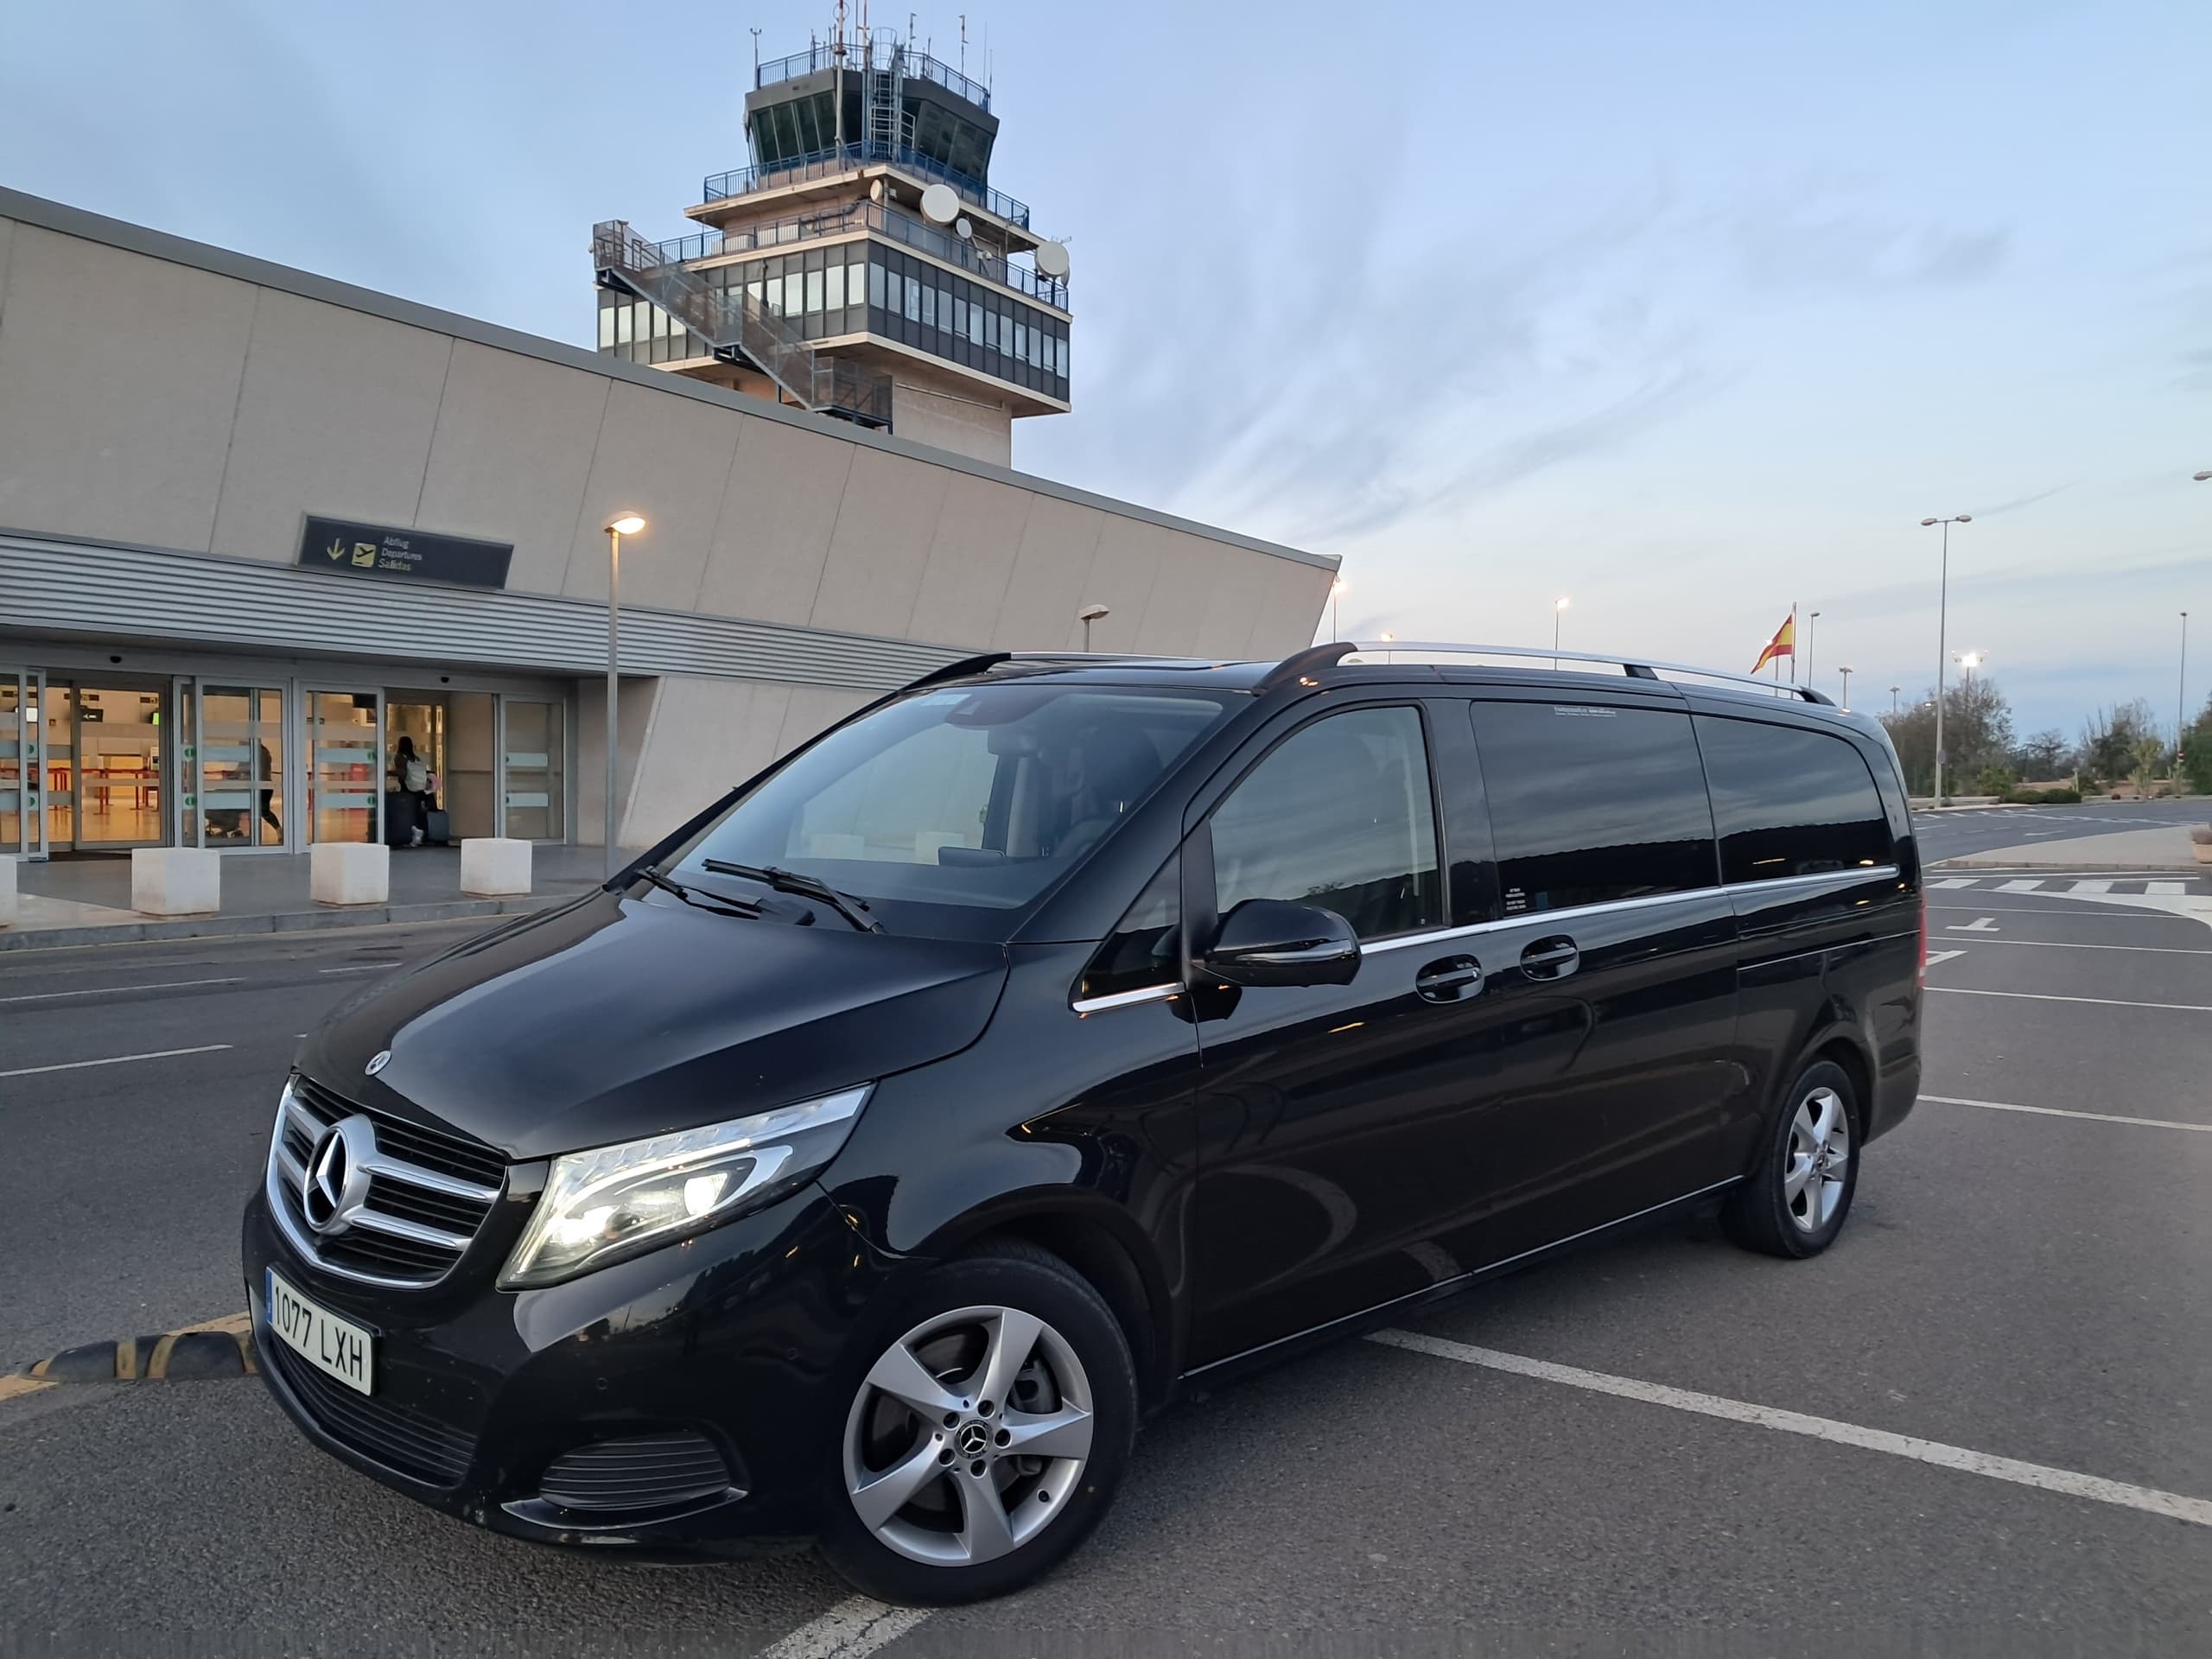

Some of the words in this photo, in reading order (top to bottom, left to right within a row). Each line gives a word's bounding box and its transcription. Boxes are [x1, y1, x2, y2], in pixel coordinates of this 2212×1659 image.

[384, 537, 410, 550] Abflug
[381, 547, 423, 561] Departures
[378, 558, 411, 571] Salidas
[276, 1286, 312, 1348] 1077
[321, 1319, 363, 1382] LXH
